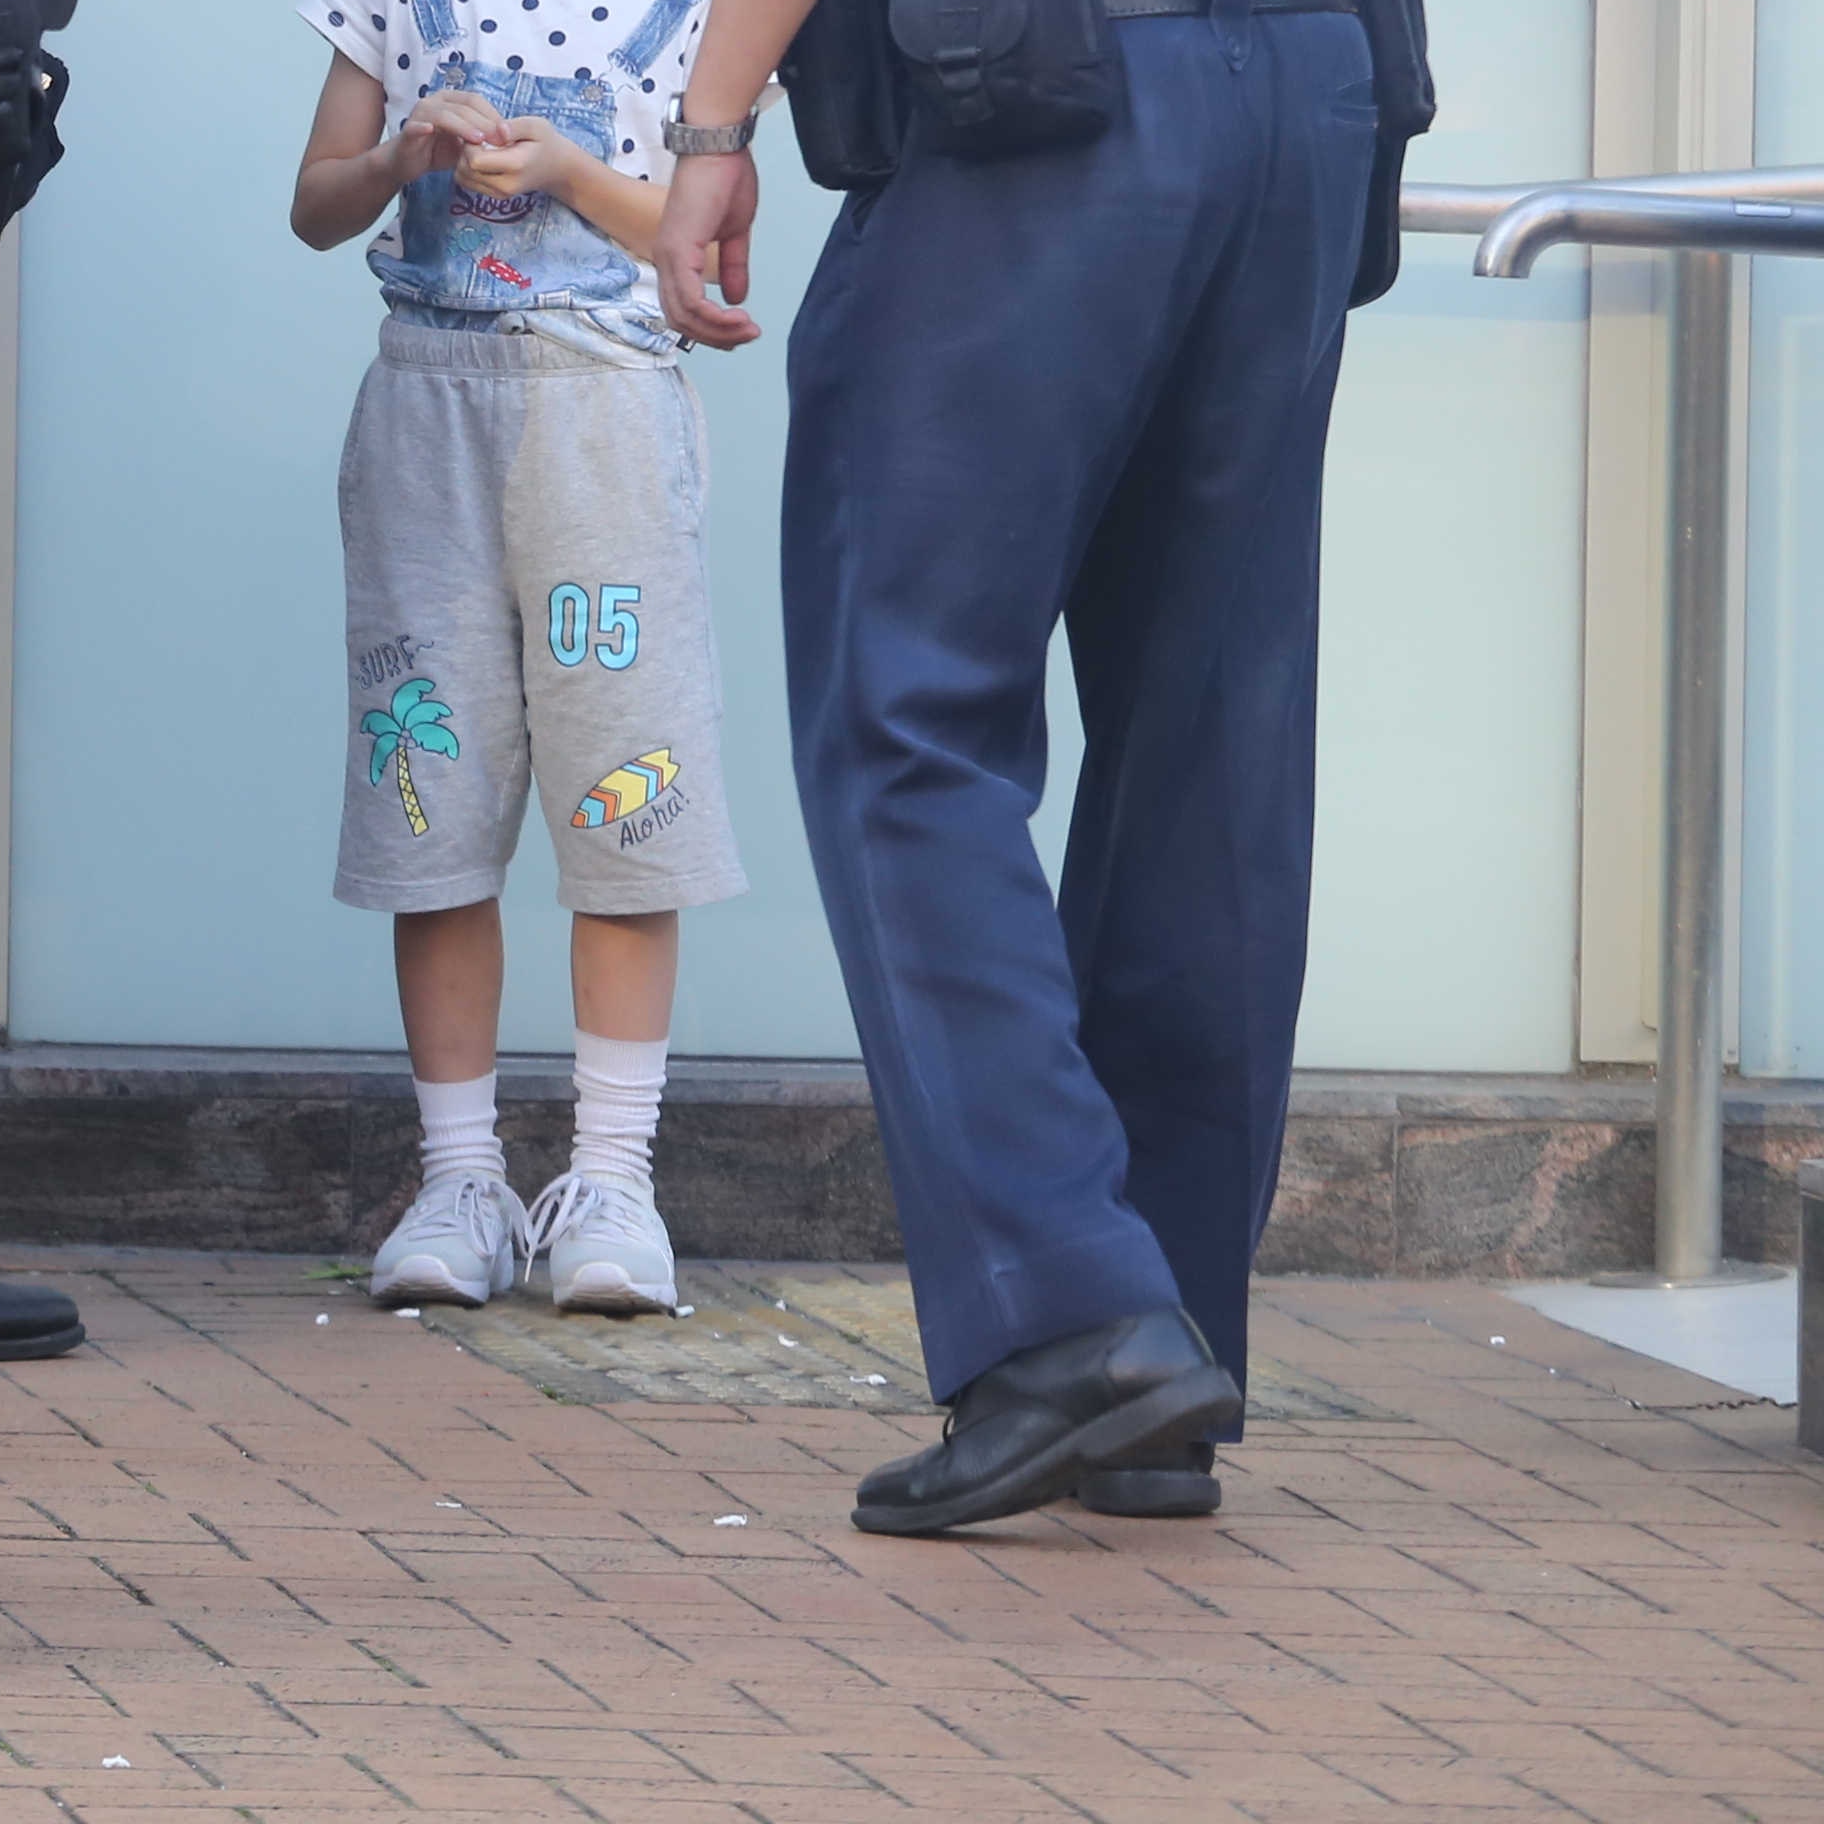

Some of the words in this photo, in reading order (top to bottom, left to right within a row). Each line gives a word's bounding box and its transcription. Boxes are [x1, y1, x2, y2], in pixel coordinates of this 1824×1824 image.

[548, 582, 642, 671] 05
[355, 634, 414, 690] SURF
[620, 784, 691, 851] Aloha!
